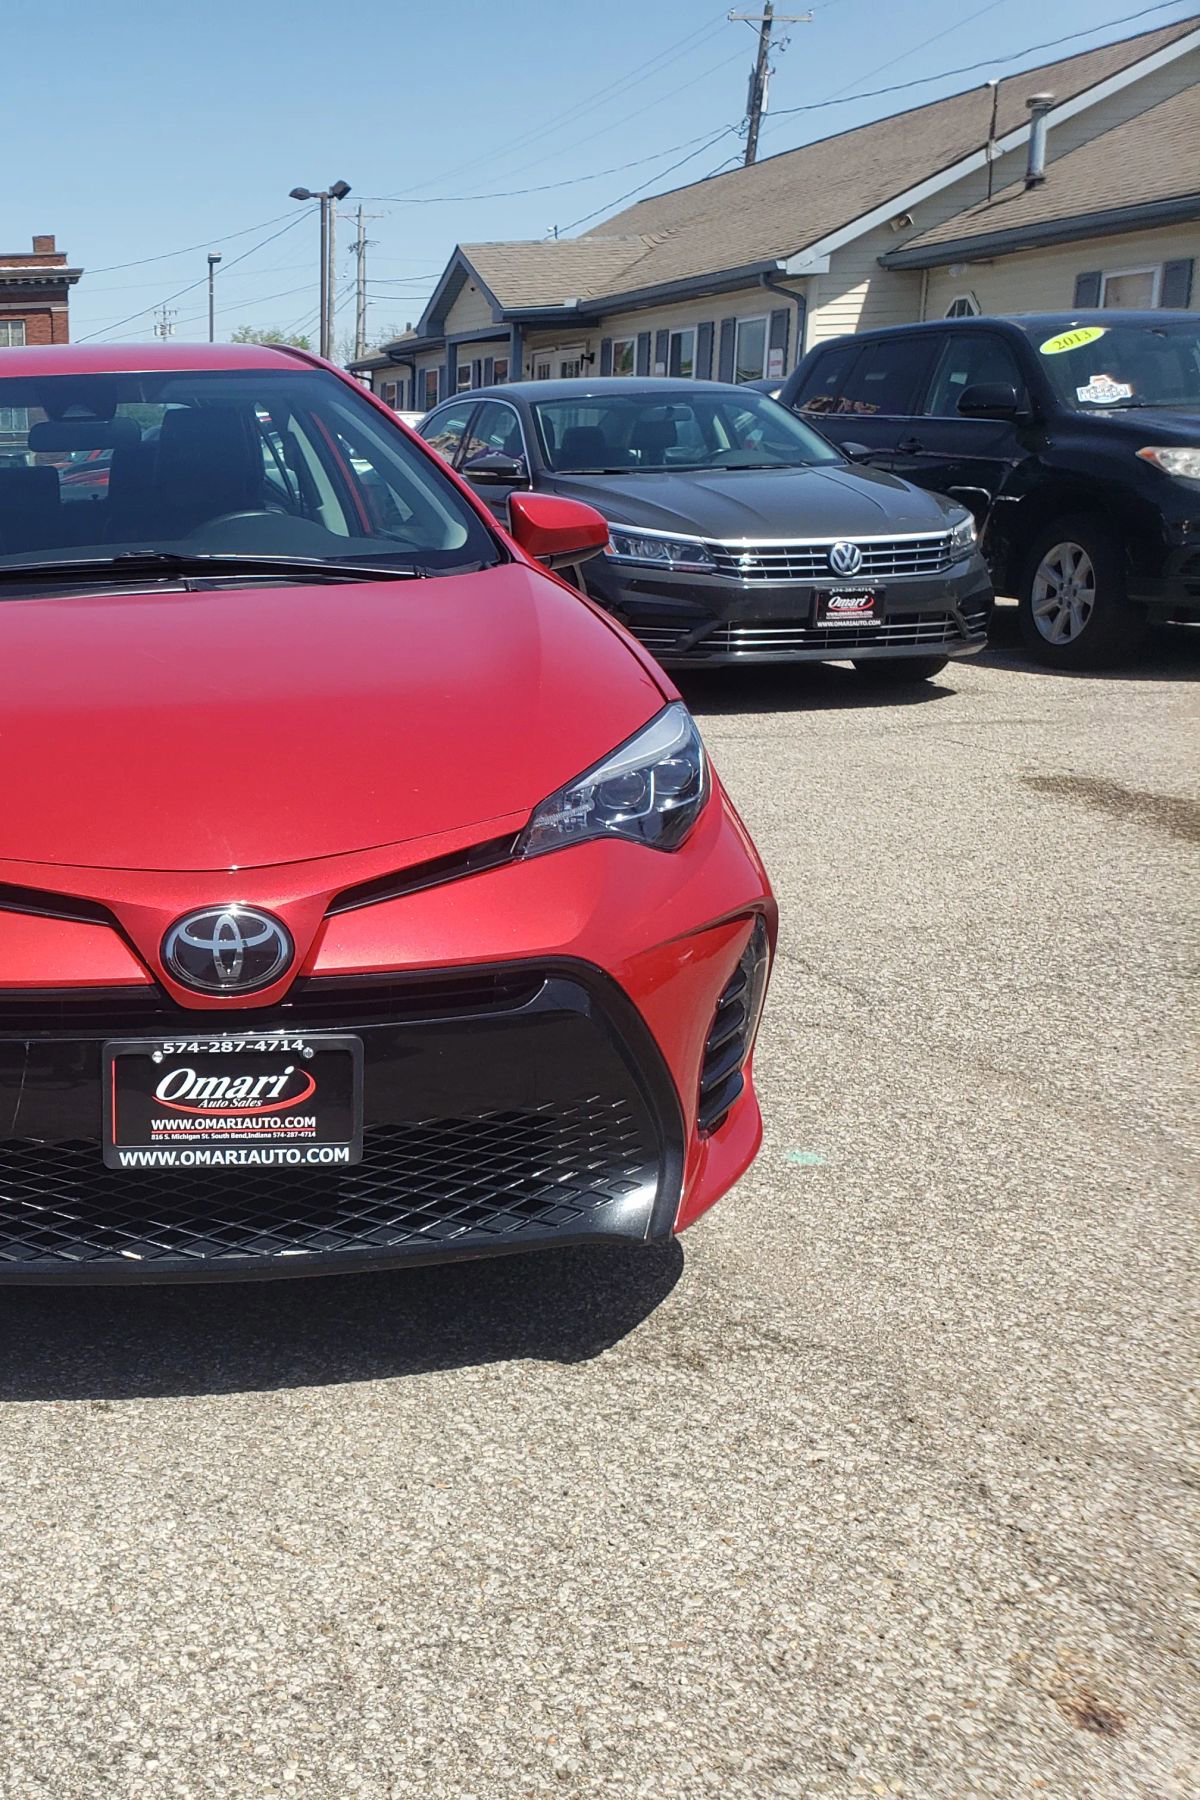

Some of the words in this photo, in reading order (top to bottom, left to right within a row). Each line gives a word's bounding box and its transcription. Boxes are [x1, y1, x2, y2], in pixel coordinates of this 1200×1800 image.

[1053, 330, 1093, 350] 2013
[828, 595, 869, 609] Omari
[162, 1039, 305, 1054] 574-287-4714
[155, 1065, 295, 1101] Omari
[197, 1098, 228, 1108] Auto
[230, 1097, 263, 1108] Sales
[151, 1116, 316, 1130] WWW.OMARIAUTO.COM
[171, 1133, 200, 1141] Michigan
[118, 1147, 350, 1167] WWW.OMARIAUTO.COM
